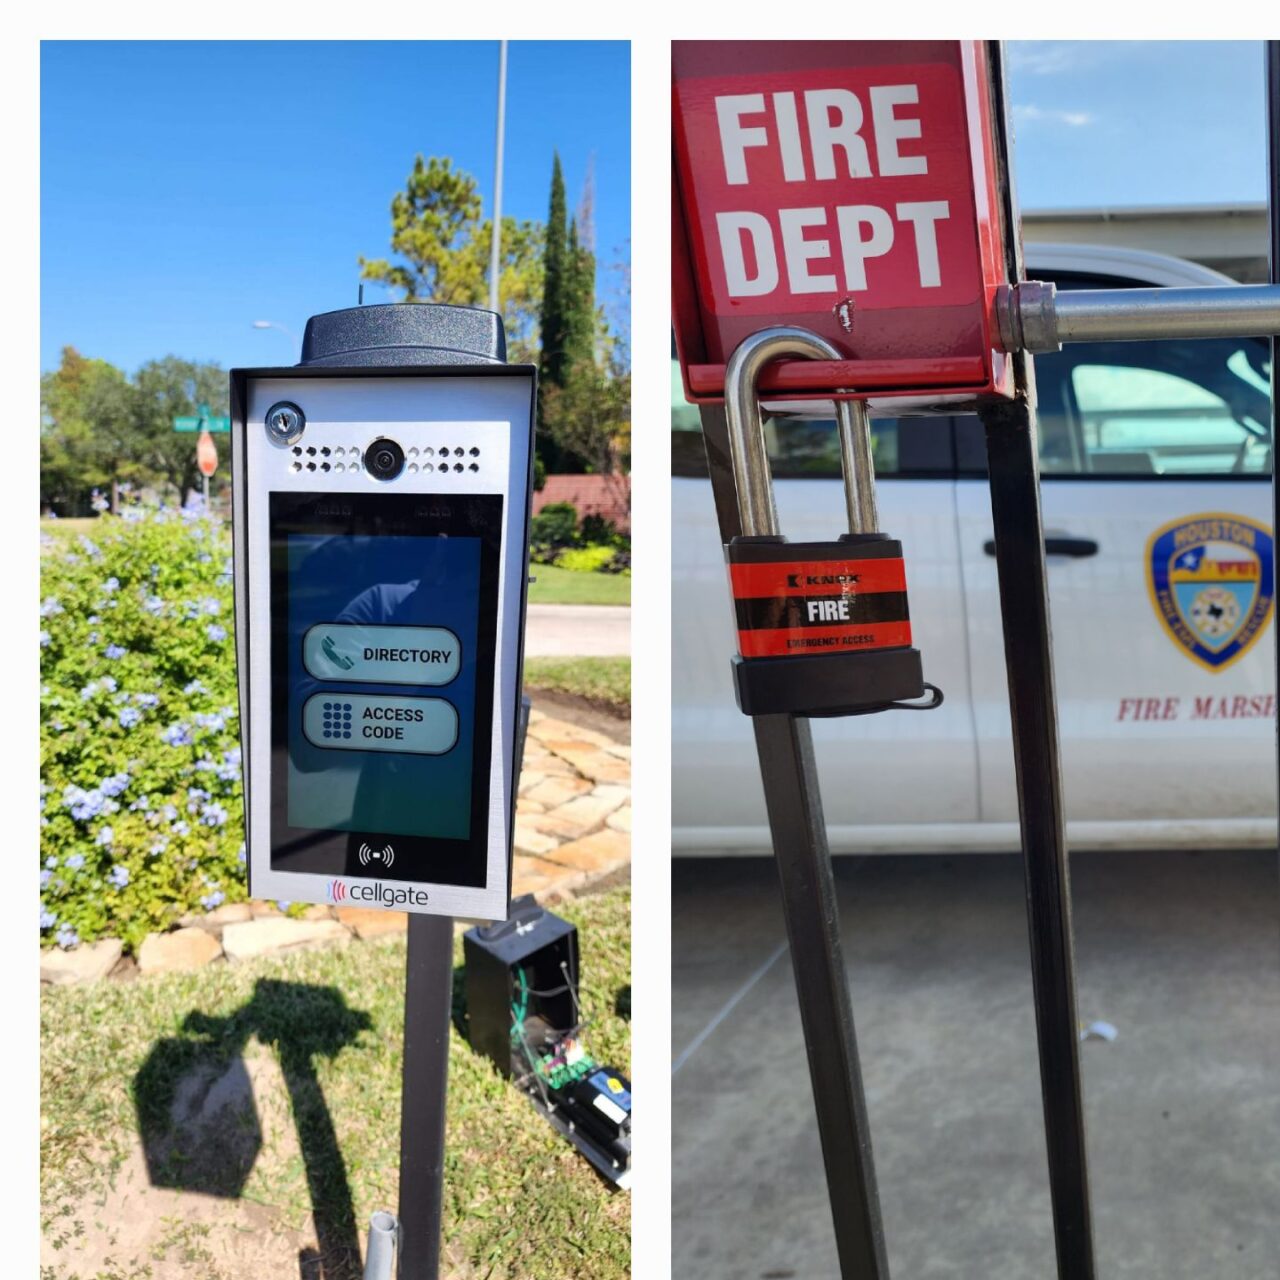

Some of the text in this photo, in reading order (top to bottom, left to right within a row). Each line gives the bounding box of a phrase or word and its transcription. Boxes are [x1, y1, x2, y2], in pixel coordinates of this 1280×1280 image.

[714, 84, 928, 185] FIRE
[715, 200, 950, 297] DEPT
[1173, 519, 1255, 548] HOUSTON
[807, 574, 861, 585] KNOX
[807, 600, 850, 622] FIRE
[786, 634, 875, 649] EMERGENCY ACCESS
[363, 647, 451, 664] DIRECTORY
[362, 706, 424, 722] ACCESS
[1115, 694, 1277, 722] FIRE MARSH
[362, 725, 404, 740] CODE
[349, 883, 429, 907] cellgate
